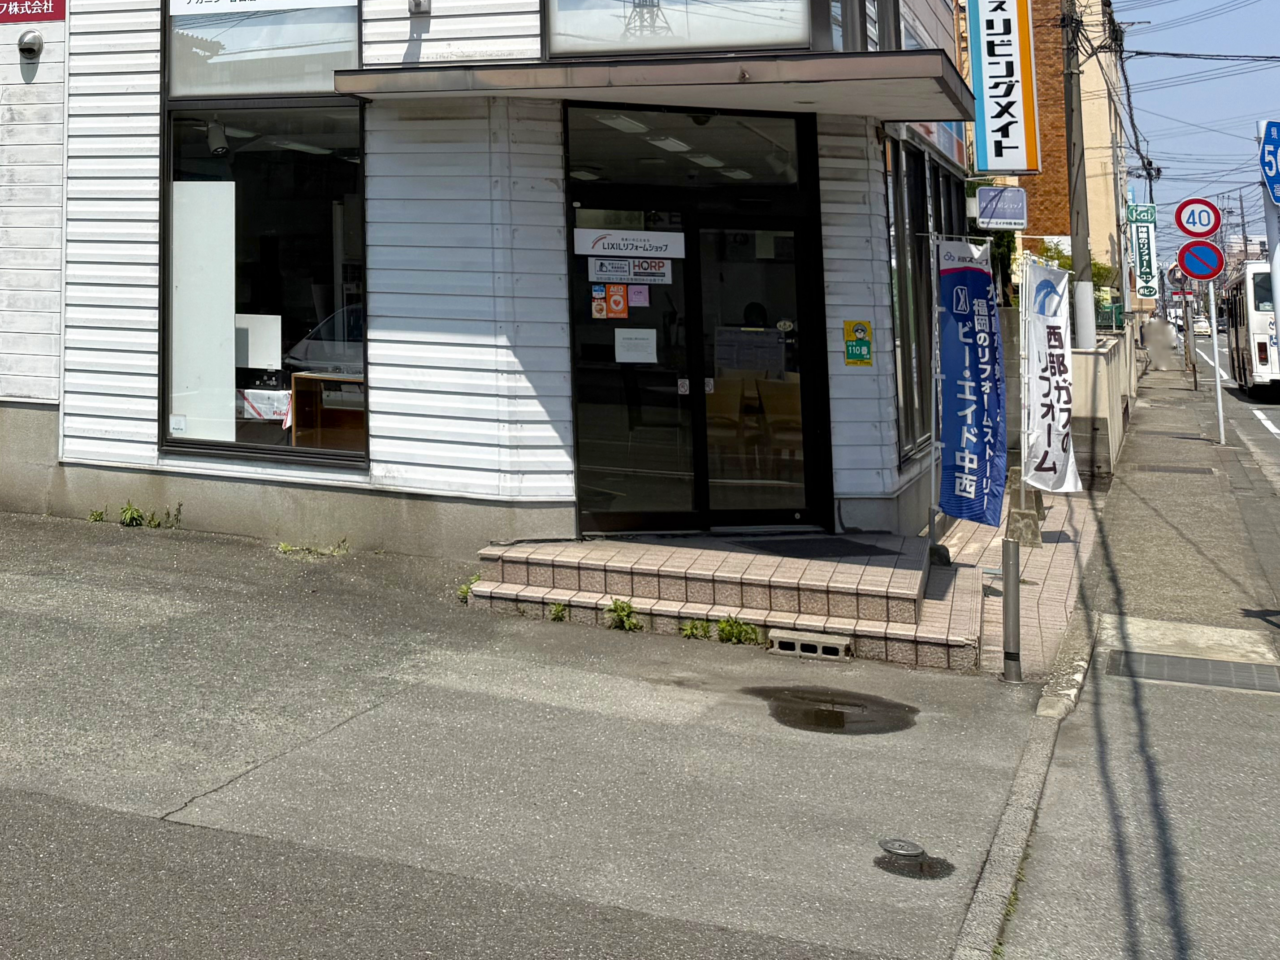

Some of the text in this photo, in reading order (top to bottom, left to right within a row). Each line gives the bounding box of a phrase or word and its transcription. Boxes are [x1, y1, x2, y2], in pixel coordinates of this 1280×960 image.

[1264, 144, 1280, 177] 5
[1132, 209, 1152, 220] Kai
[1185, 209, 1211, 227] 40
[602, 242, 668, 252] LIXILリフォームショップ
[633, 260, 665, 271] HORP
[973, 299, 994, 510] 福岡のリフォームストーリー
[1034, 351, 1057, 475] リフォーム
